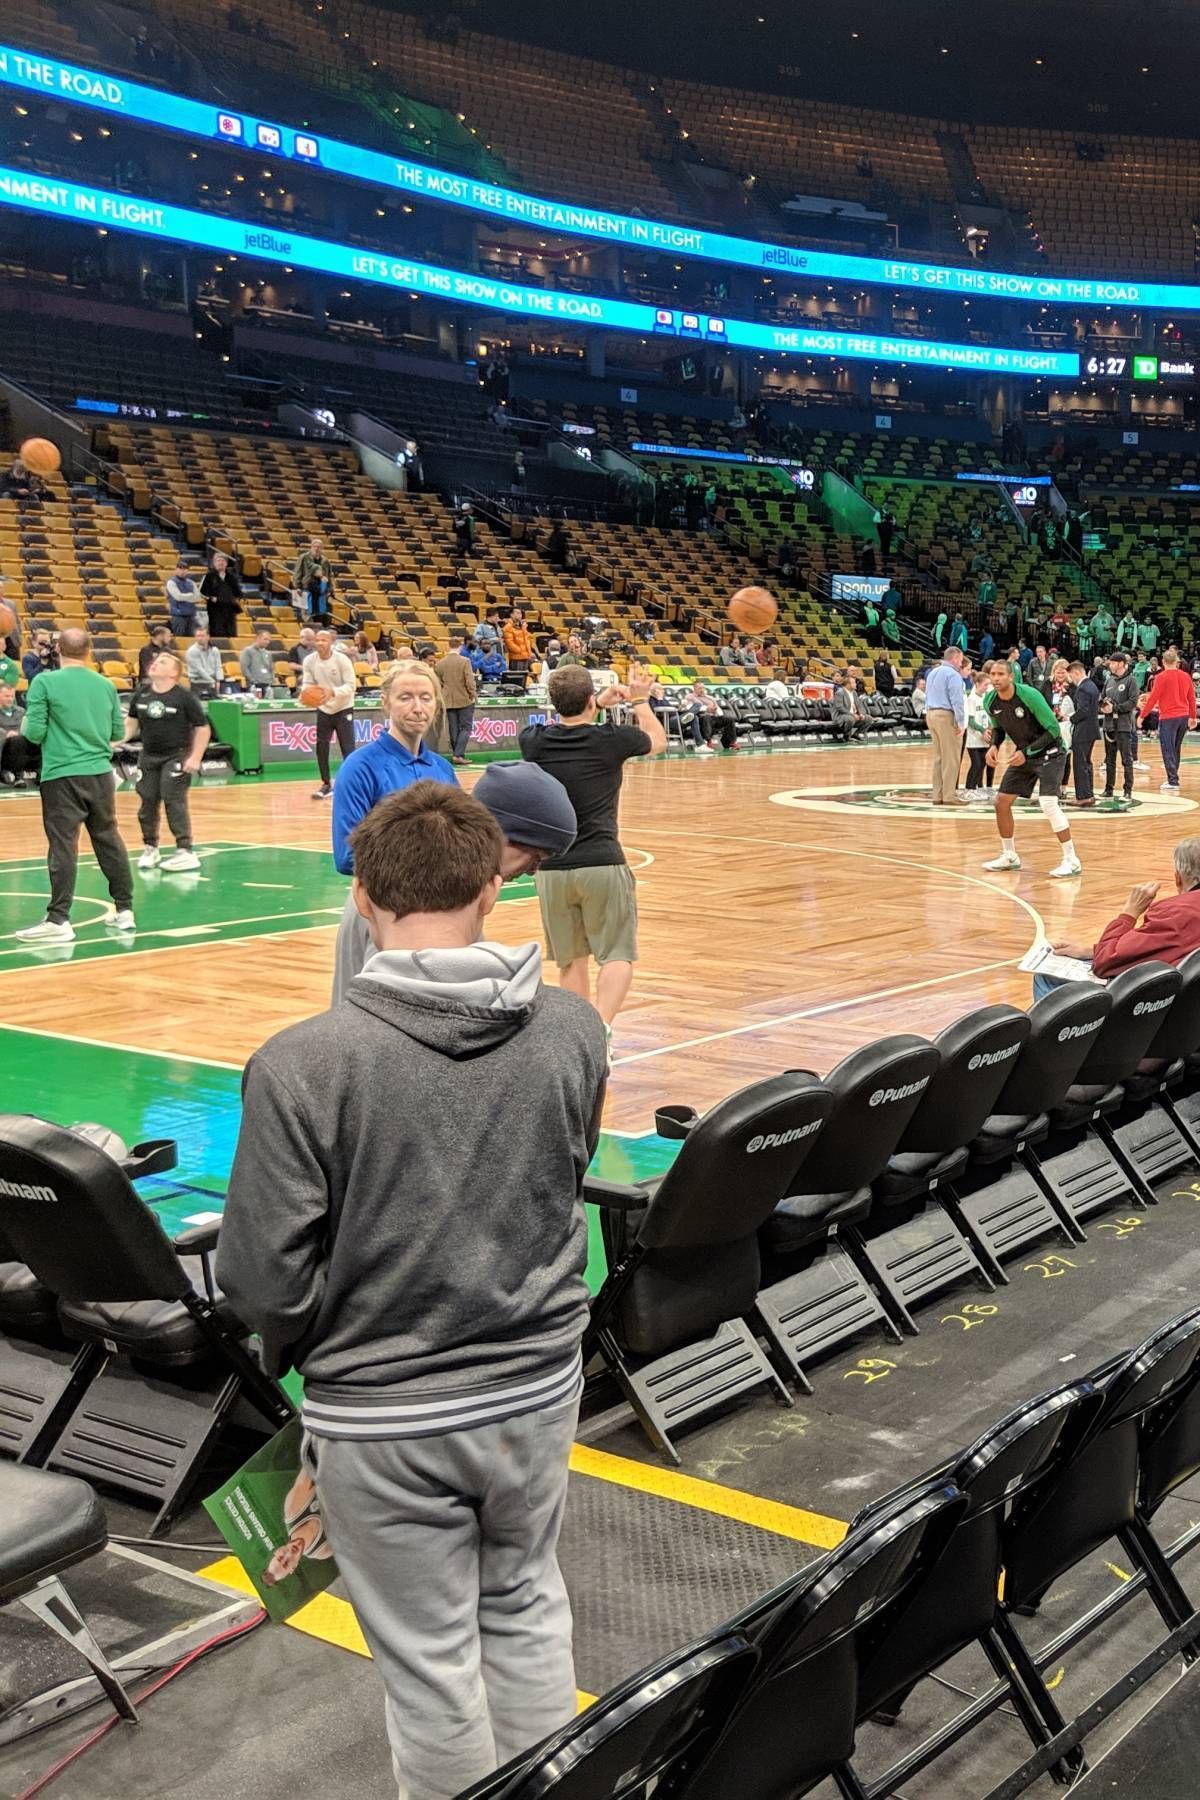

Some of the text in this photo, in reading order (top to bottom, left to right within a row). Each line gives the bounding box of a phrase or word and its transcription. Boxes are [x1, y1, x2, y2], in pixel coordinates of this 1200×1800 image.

[14, 56, 125, 105] THE ROAD.
[74, 192, 167, 229] IN FLIGHT.
[396, 163, 704, 250] THE MOST FREE ENTERTAINMENT IN FLIGHT.
[243, 228, 292, 256] jetBlue
[761, 248, 808, 268] jetBlue
[353, 256, 604, 318] LET'S GET THIS SHOW ON THE ROAD.
[884, 264, 1140, 301] LET'S GET THIS SHOW ON THE ROAD.
[773, 332, 1059, 370] THE MOST FREE ENTERTAINMENT IN FLIGHT.
[1087, 357, 1126, 375] 6:27
[1136, 358, 1195, 377] TD Bank
[799, 470, 815, 485] 10
[1022, 486, 1038, 500] 10
[1143, 994, 1176, 1014] Putnam
[1069, 1015, 1106, 1039] Putnam
[980, 1041, 1021, 1067] Putnam
[881, 1075, 931, 1104] Putnam
[761, 1118, 824, 1150] Putnam
[1096, 1217, 1142, 1235] 26
[1023, 1255, 1079, 1278] 27
[940, 1303, 999, 1331] 28
[842, 1357, 897, 1385] 29
